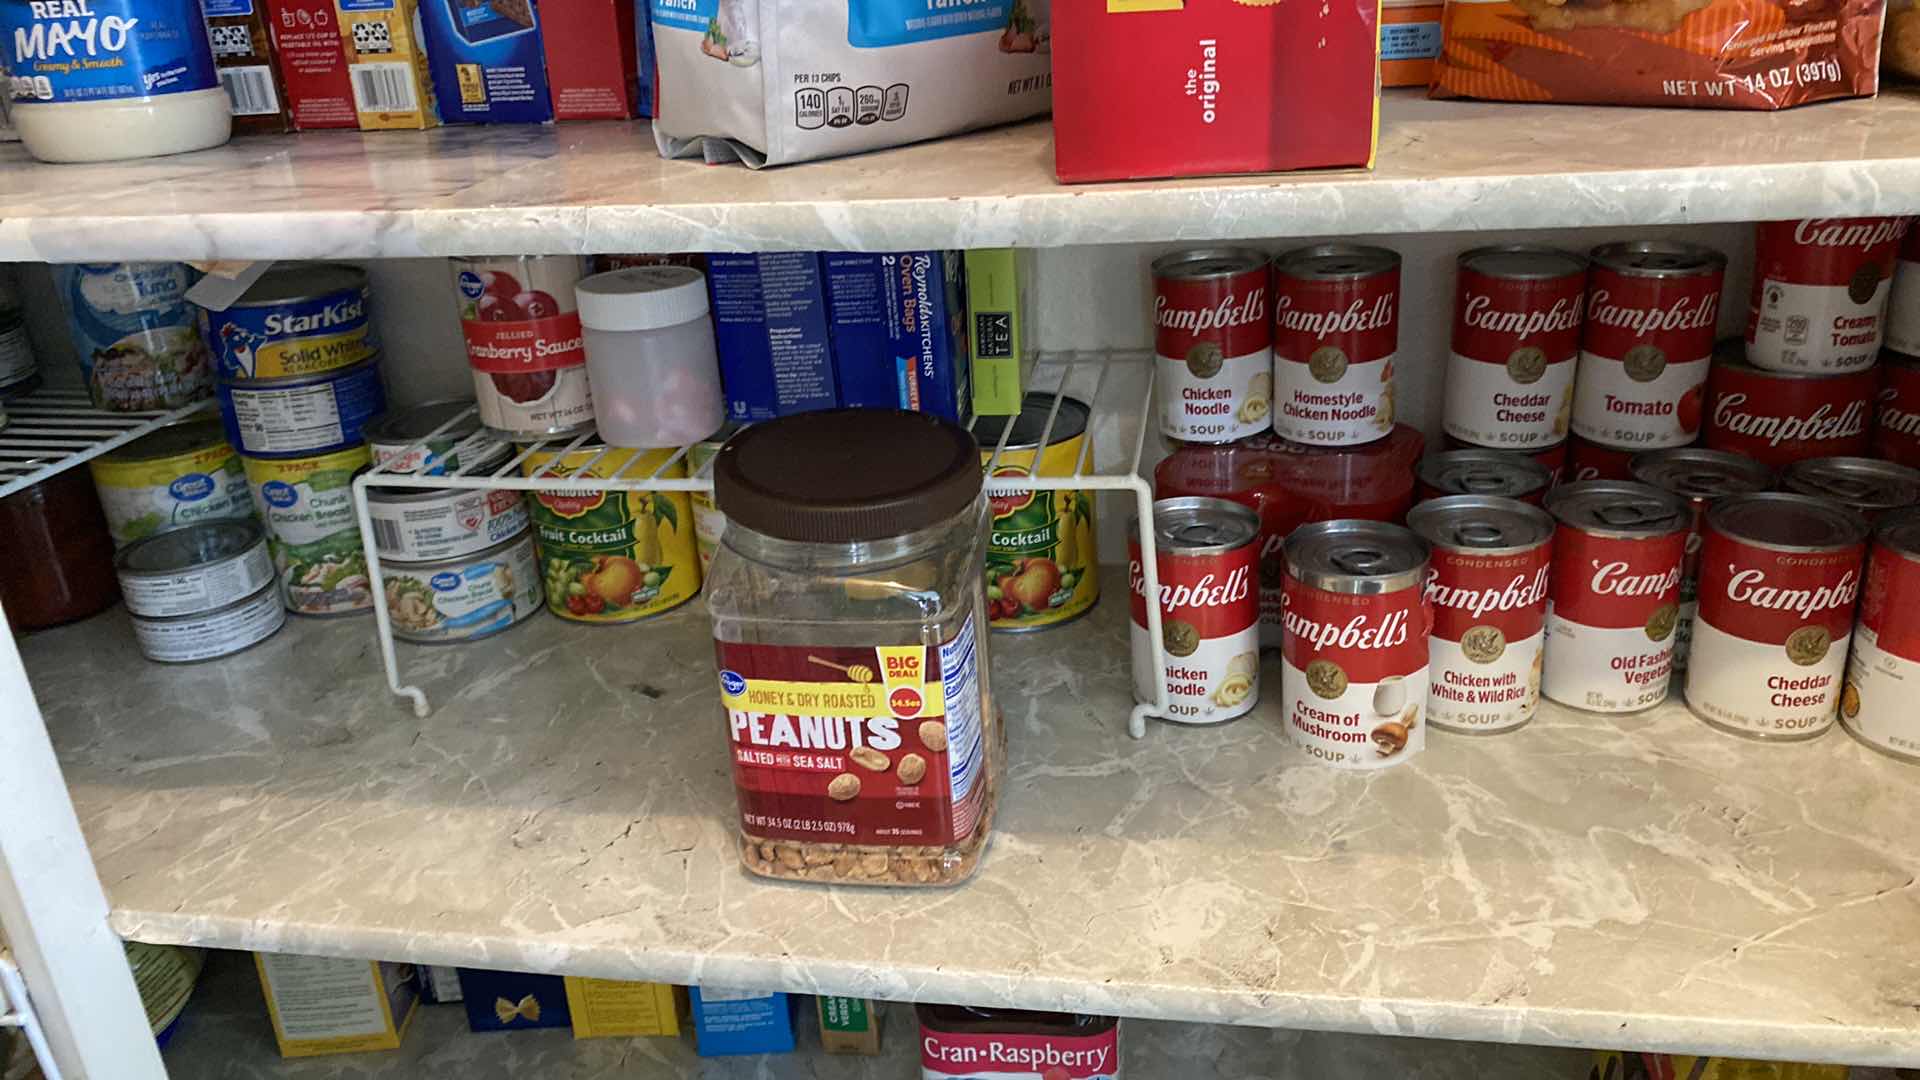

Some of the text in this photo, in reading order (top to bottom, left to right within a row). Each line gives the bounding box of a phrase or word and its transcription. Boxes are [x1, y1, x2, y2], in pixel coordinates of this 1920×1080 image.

[31, 0, 95, 19] REAL
[1803, 20, 1837, 33] Texture
[14, 15, 138, 62] MAYO
[1750, 33, 1836, 57] Serving Suggestion
[794, 73, 841, 82] PER 13 CHIPS
[1185, 69, 1198, 95] the
[1199, 39, 1220, 123] original
[1663, 59, 1841, 97] NET WT 14 OZ (397g)
[800, 94, 821, 109] 140
[882, 256, 896, 266] 2
[900, 255, 916, 332] Oven Bags
[264, 300, 363, 336] StarKist
[1153, 287, 1264, 337] Campbell's
[1275, 292, 1394, 340] Campbell's
[496, 330, 534, 340] JELLIED
[995, 315, 1009, 355] TEA
[535, 337, 584, 357] Sauce
[280, 347, 321, 366] Solid
[1182, 387, 1232, 400] Chicken
[1294, 390, 1364, 407] Homestyle
[1493, 393, 1552, 408] Cheddar
[1184, 402, 1231, 416] Noodle
[1283, 403, 1377, 421] Chicken Noodle
[1604, 395, 1673, 416] Tomato
[1496, 409, 1546, 424] Cheese
[1713, 392, 1866, 447] Campbell's
[1189, 424, 1226, 436] SOUP
[1308, 430, 1345, 441] SOUP
[1500, 432, 1538, 443] SOUP
[1614, 430, 1655, 442] SOUP
[540, 526, 628, 544] Fruit Cocktail
[992, 527, 1051, 546] Cocktail
[1447, 556, 1529, 569] CONDENSED
[1281, 594, 1409, 652] Campbell's
[886, 656, 919, 669] BIG
[1610, 656, 1636, 670] Old
[888, 669, 918, 678] DEAL!
[1444, 670, 1517, 688] Chicken with
[1767, 674, 1832, 690] Cheddar
[721, 674, 744, 692] Kroger
[748, 689, 876, 709] HONEY & DRY ROASTED
[1431, 683, 1527, 703] White & Wild Rice
[1770, 692, 1826, 708] Cheese
[1169, 704, 1200, 717] OUP
[1296, 700, 1360, 727] Cream of
[1456, 712, 1500, 725] SOUP
[729, 710, 902, 751] PEANUTS
[1292, 713, 1367, 744] Mushroom
[1773, 716, 1818, 730] SOUP
[737, 749, 774, 766] SALTED
[793, 756, 814, 769] SEA
[816, 756, 844, 770] SALT
[1305, 744, 1345, 763] SOUP
[744, 813, 856, 835] NET WT 34.5 OZ (2 LB 2.5 OZ) 978g
